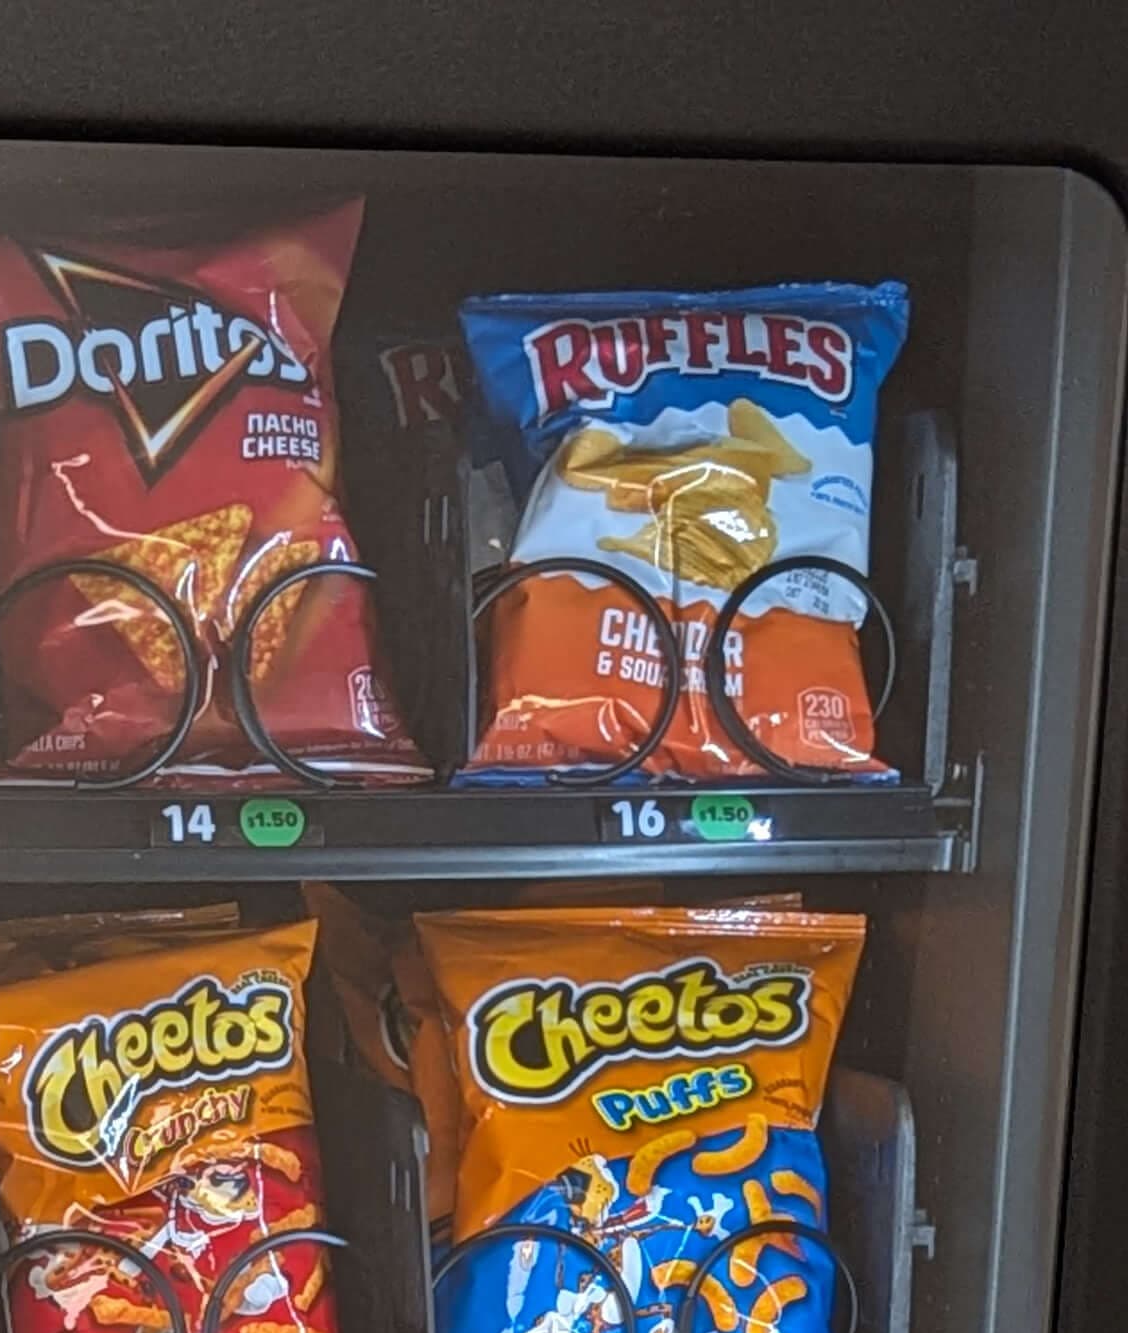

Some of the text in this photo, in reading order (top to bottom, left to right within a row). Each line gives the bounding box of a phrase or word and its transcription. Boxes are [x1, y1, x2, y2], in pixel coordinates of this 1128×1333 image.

[533, 313, 851, 413] RUFFLES
[248, 414, 319, 438] NACHO
[242, 435, 320, 462] CHEESE
[598, 655, 613, 676] &
[806, 694, 844, 718] 230
[162, 804, 216, 842] 14
[246, 811, 298, 829] $1.50
[612, 800, 666, 837] 16
[699, 804, 749, 823] $1.50
[482, 967, 796, 1090] Cheetos
[36, 987, 284, 1155] Cheetos
[597, 1065, 753, 1128] Puffs
[124, 1085, 252, 1166] Crunchy
